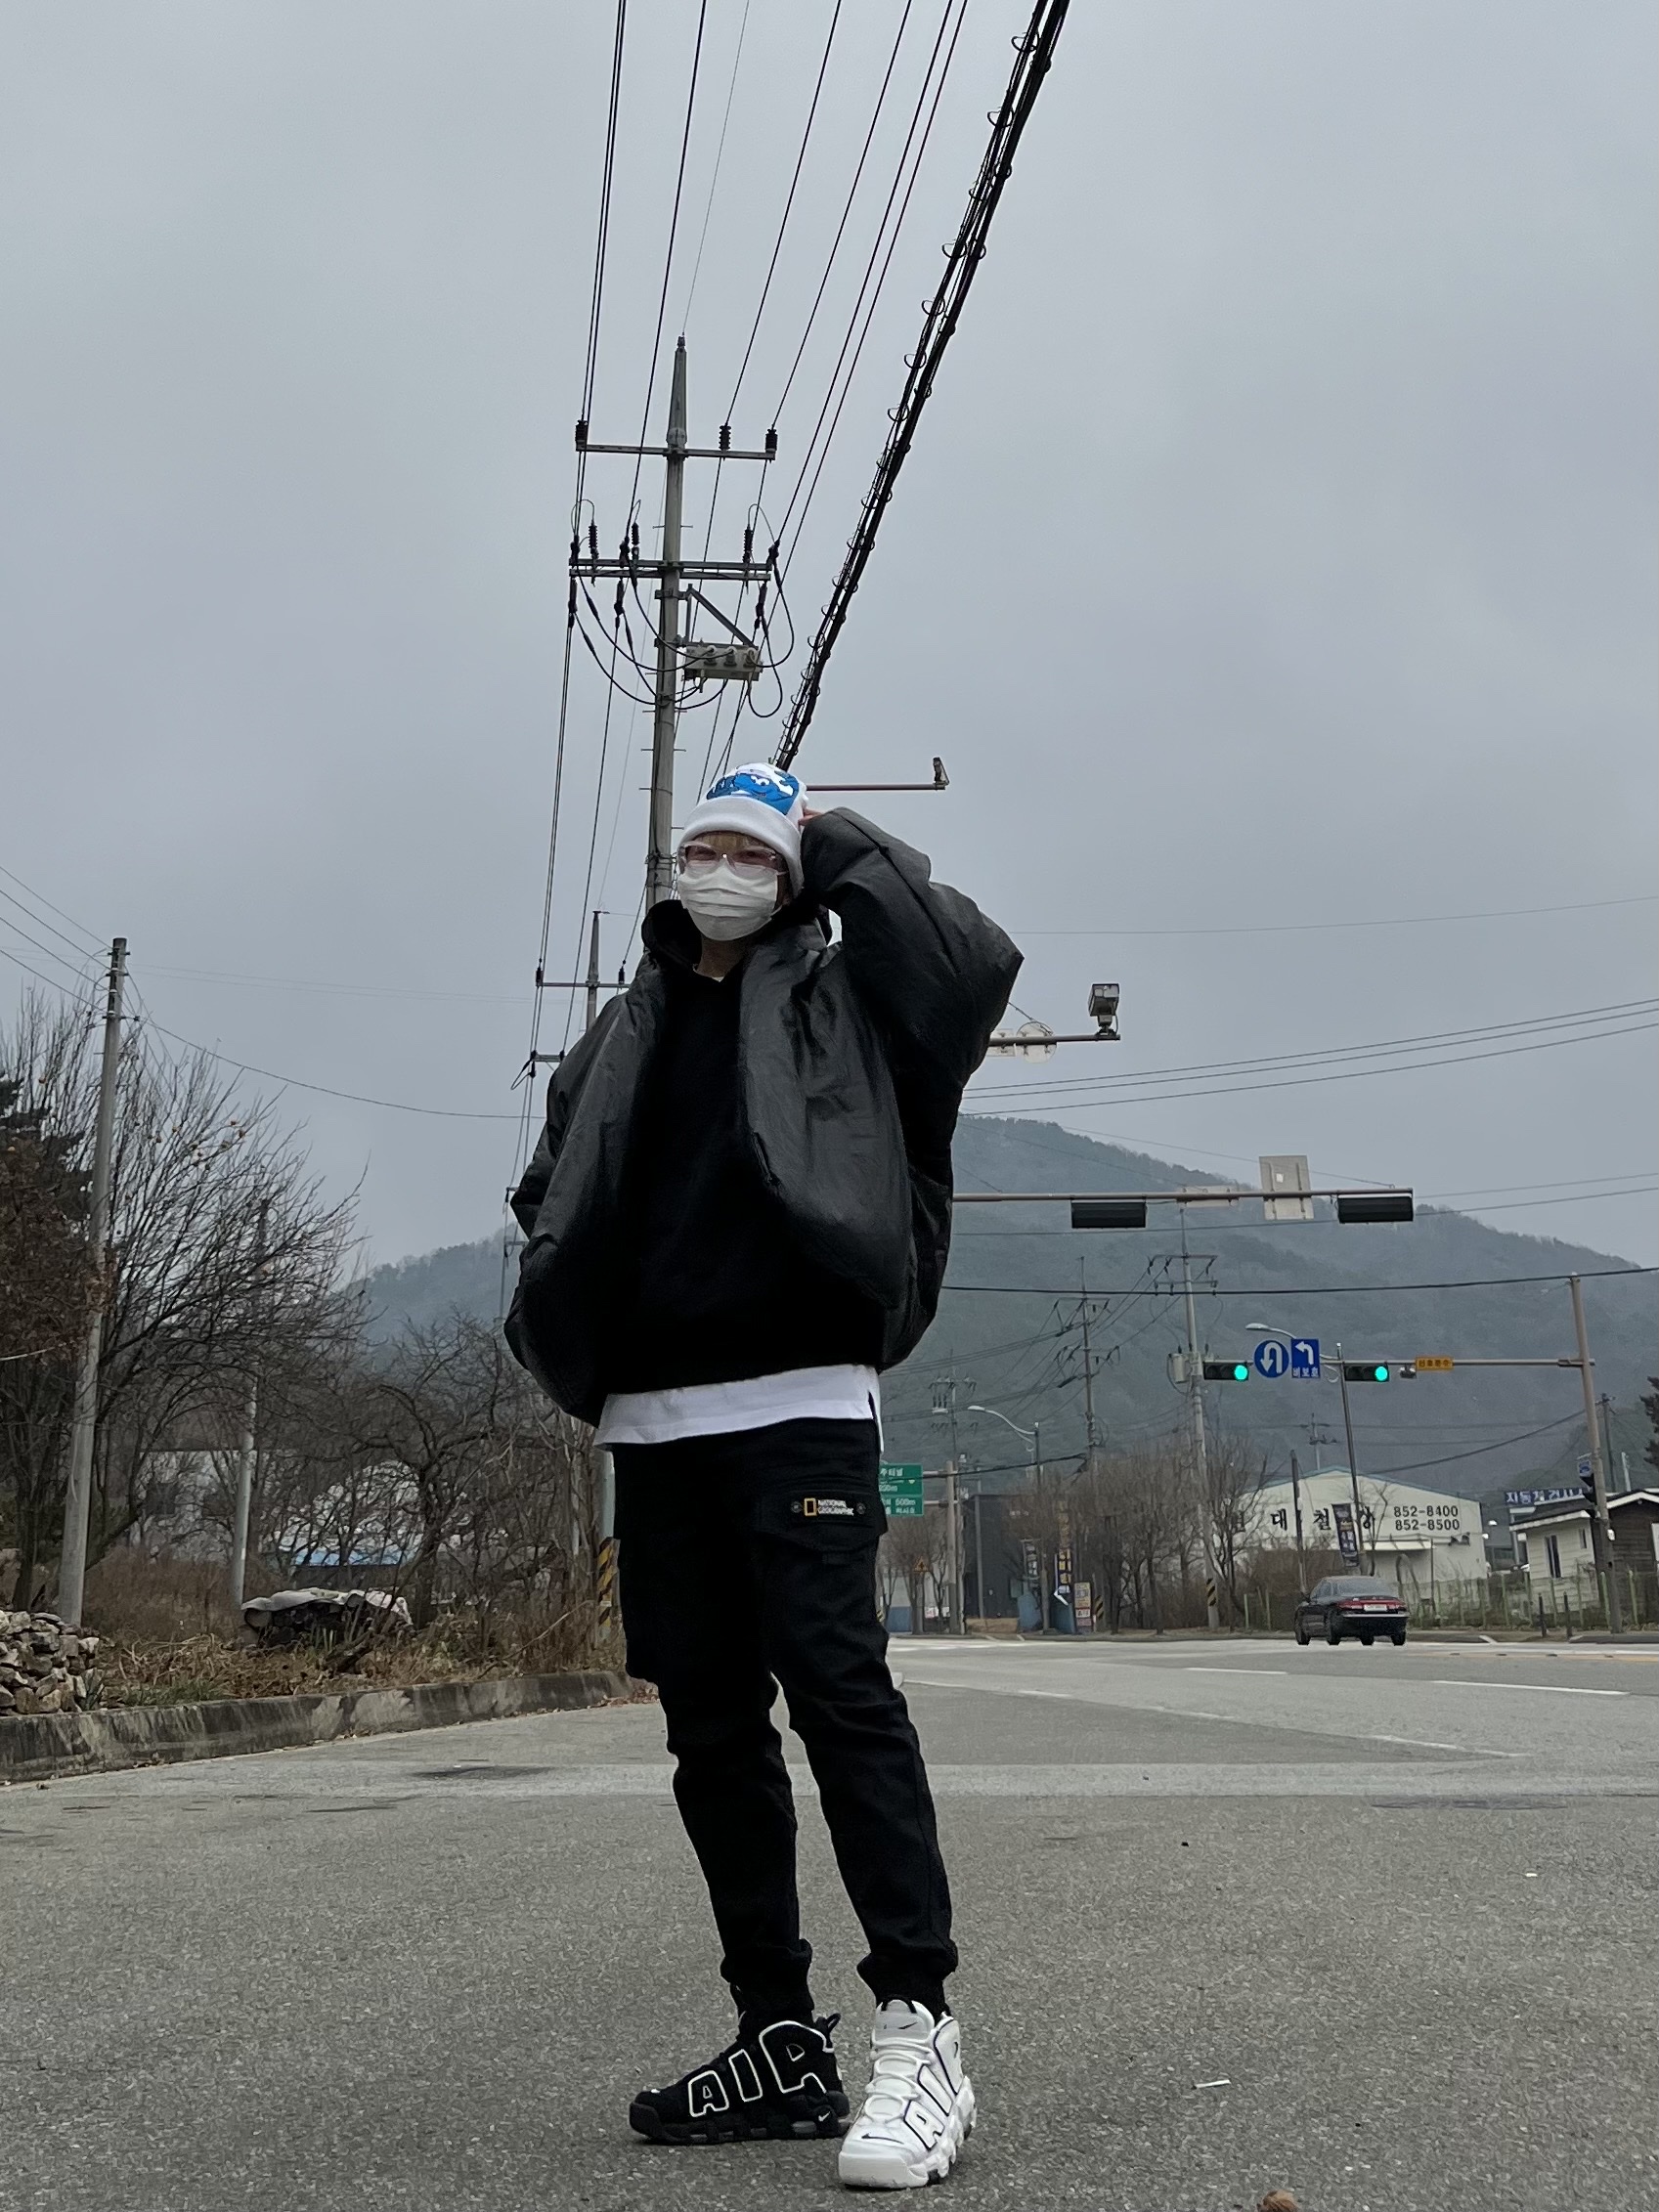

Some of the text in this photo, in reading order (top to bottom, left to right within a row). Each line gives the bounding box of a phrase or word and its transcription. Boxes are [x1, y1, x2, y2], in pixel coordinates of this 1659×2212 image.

[1292, 1366, 1319, 1378] 비보호
[1393, 1505, 1459, 1517] 852-8400
[1395, 1519, 1461, 1531] 852-8500
[687, 2019, 835, 2119] AIR
